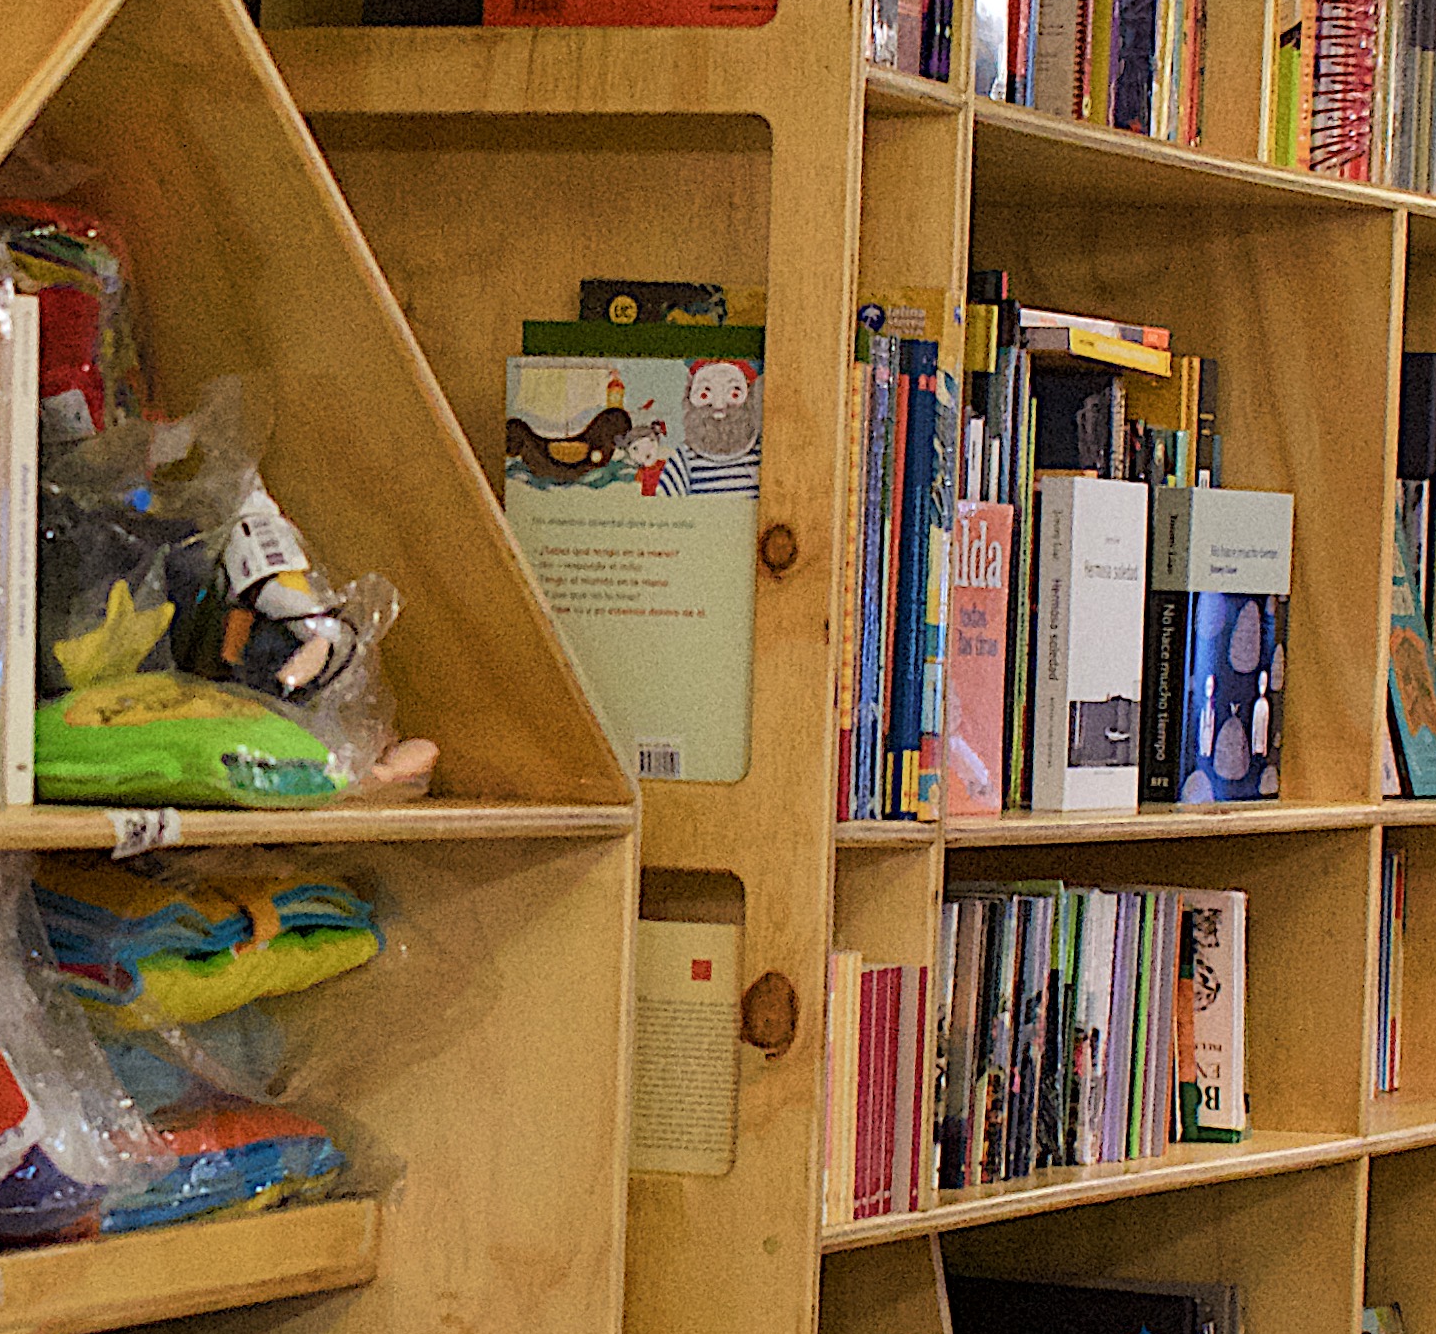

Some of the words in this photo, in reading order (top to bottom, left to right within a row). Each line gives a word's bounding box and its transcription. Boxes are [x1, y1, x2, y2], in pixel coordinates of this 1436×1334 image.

[1163, 602, 1176, 622] No
[1161, 623, 1174, 655] hace
[1159, 656, 1173, 703] mucho
[1156, 704, 1171, 762] tiempo
